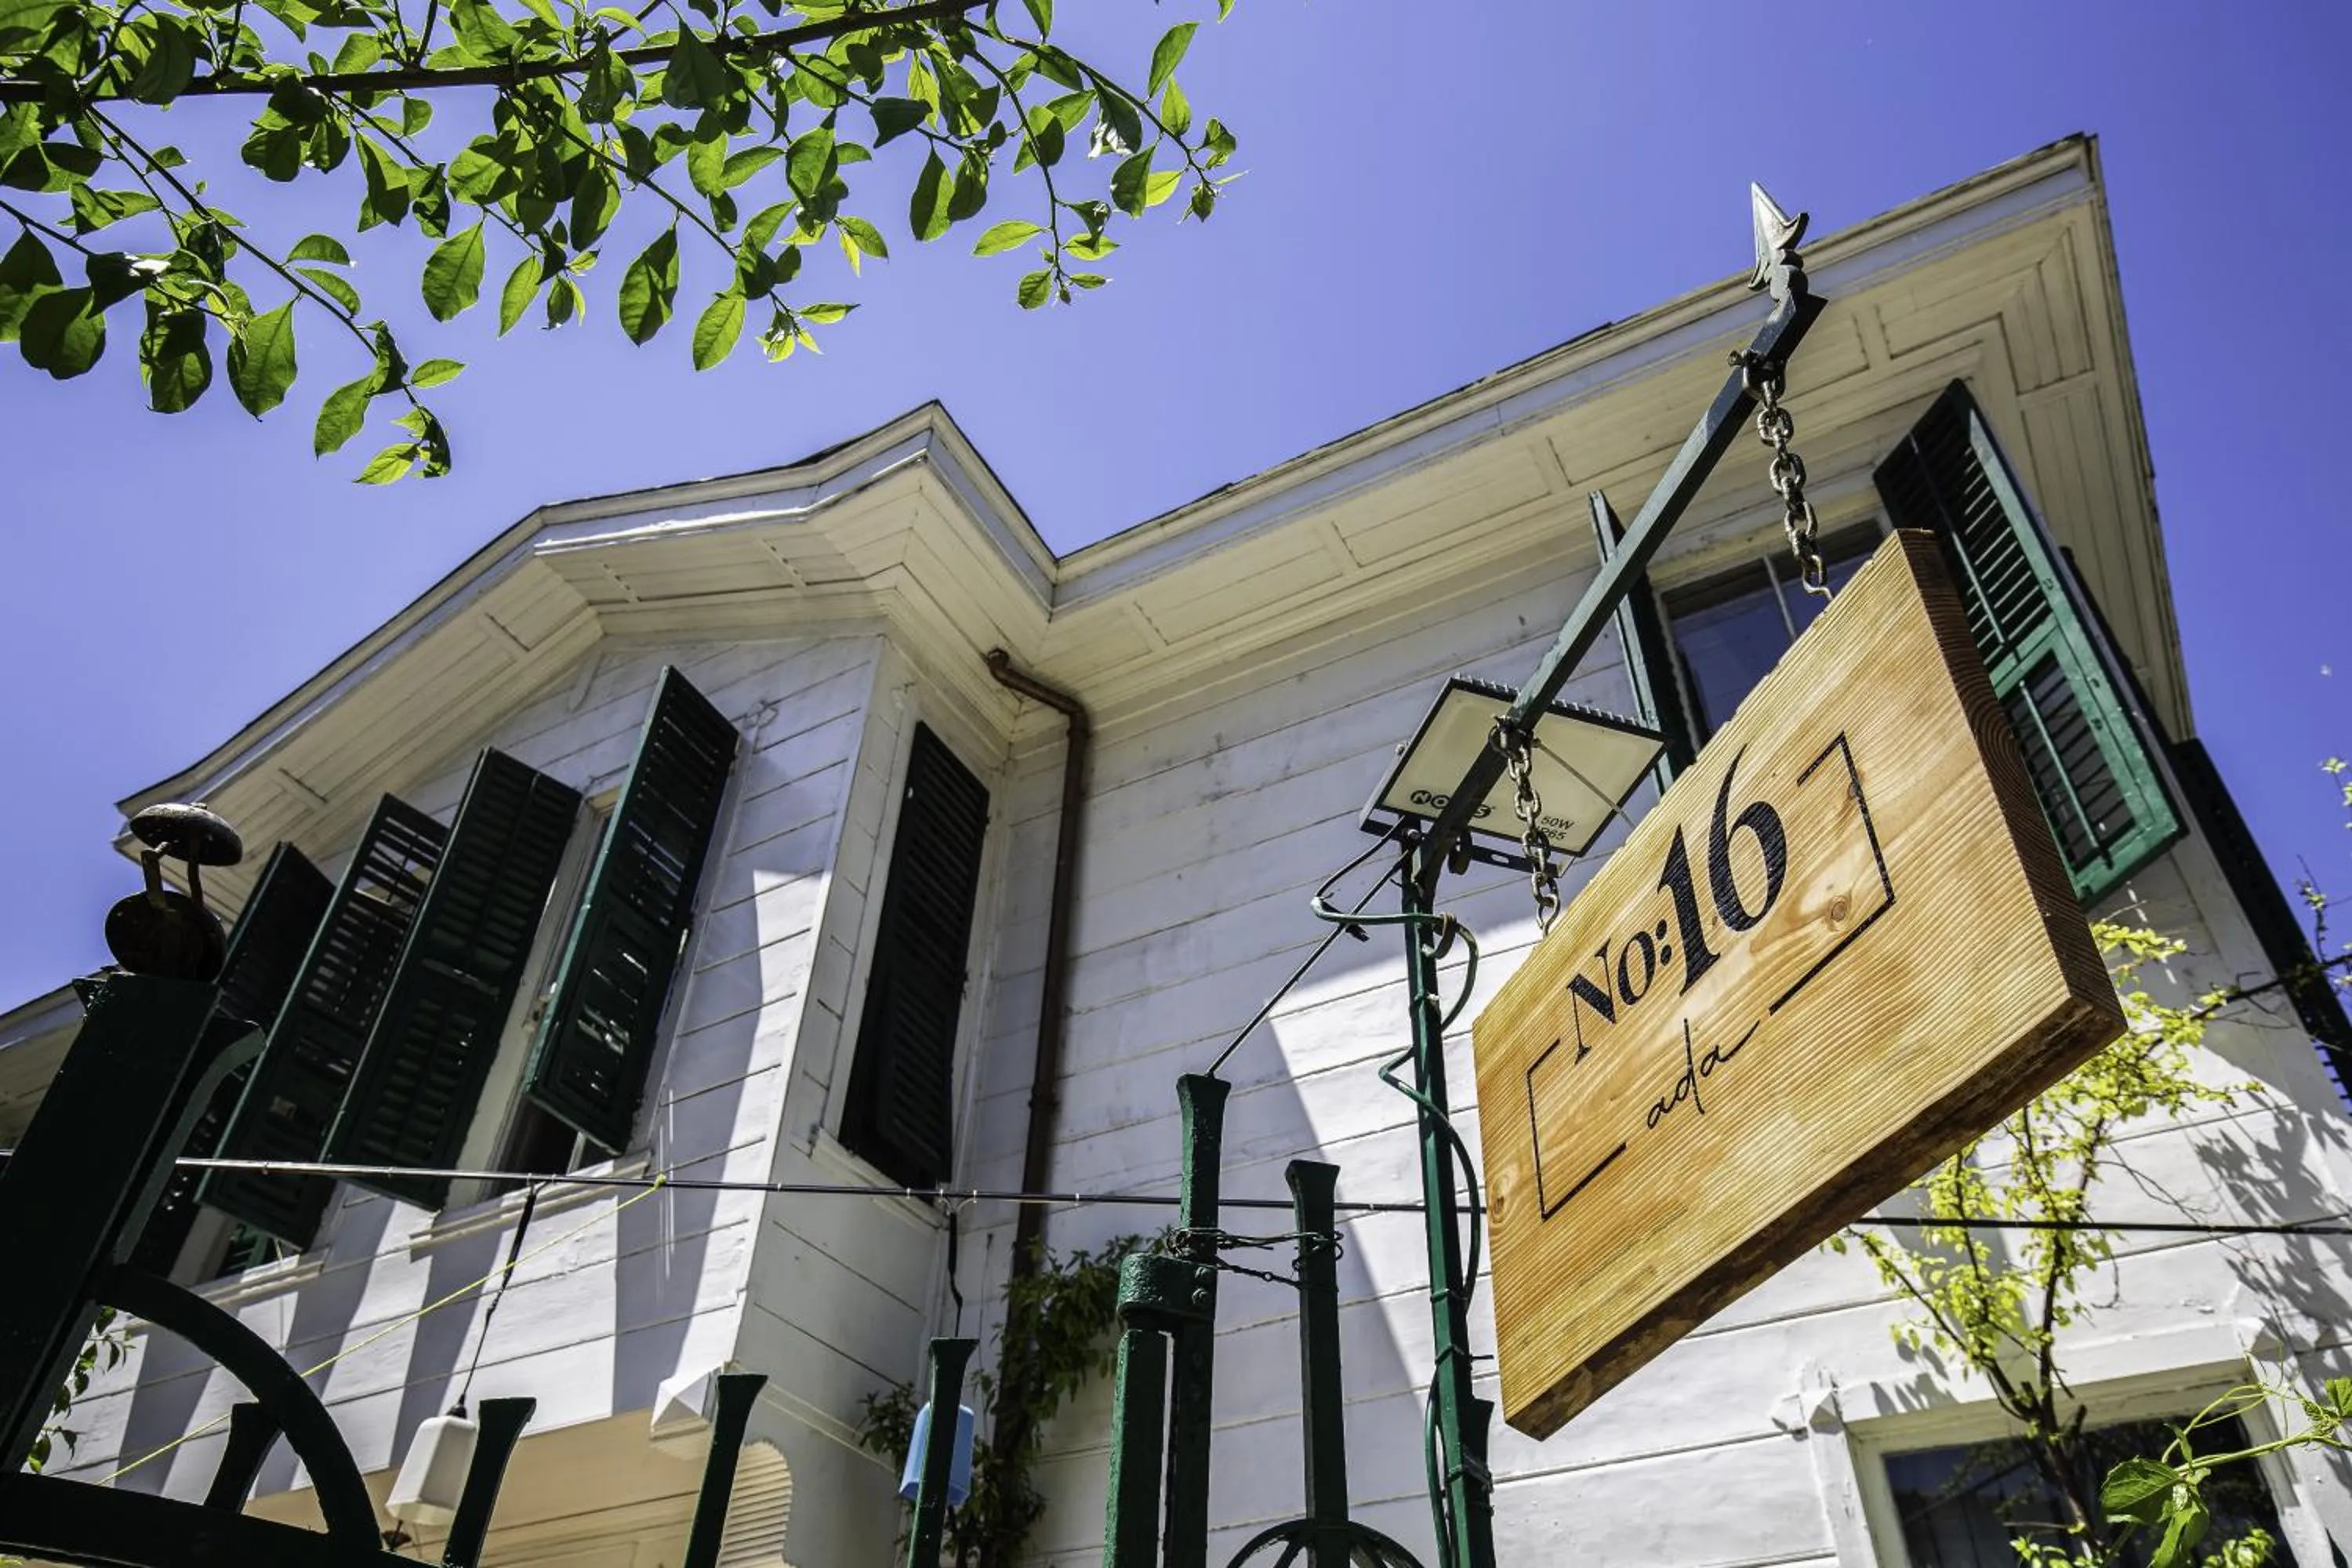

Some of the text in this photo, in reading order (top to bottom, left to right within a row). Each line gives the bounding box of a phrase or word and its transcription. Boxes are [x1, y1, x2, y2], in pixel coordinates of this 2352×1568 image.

[1410, 790, 1491, 818] NOS
[1541, 815, 1575, 829] 50W
[1647, 1018, 1761, 1129] ada
